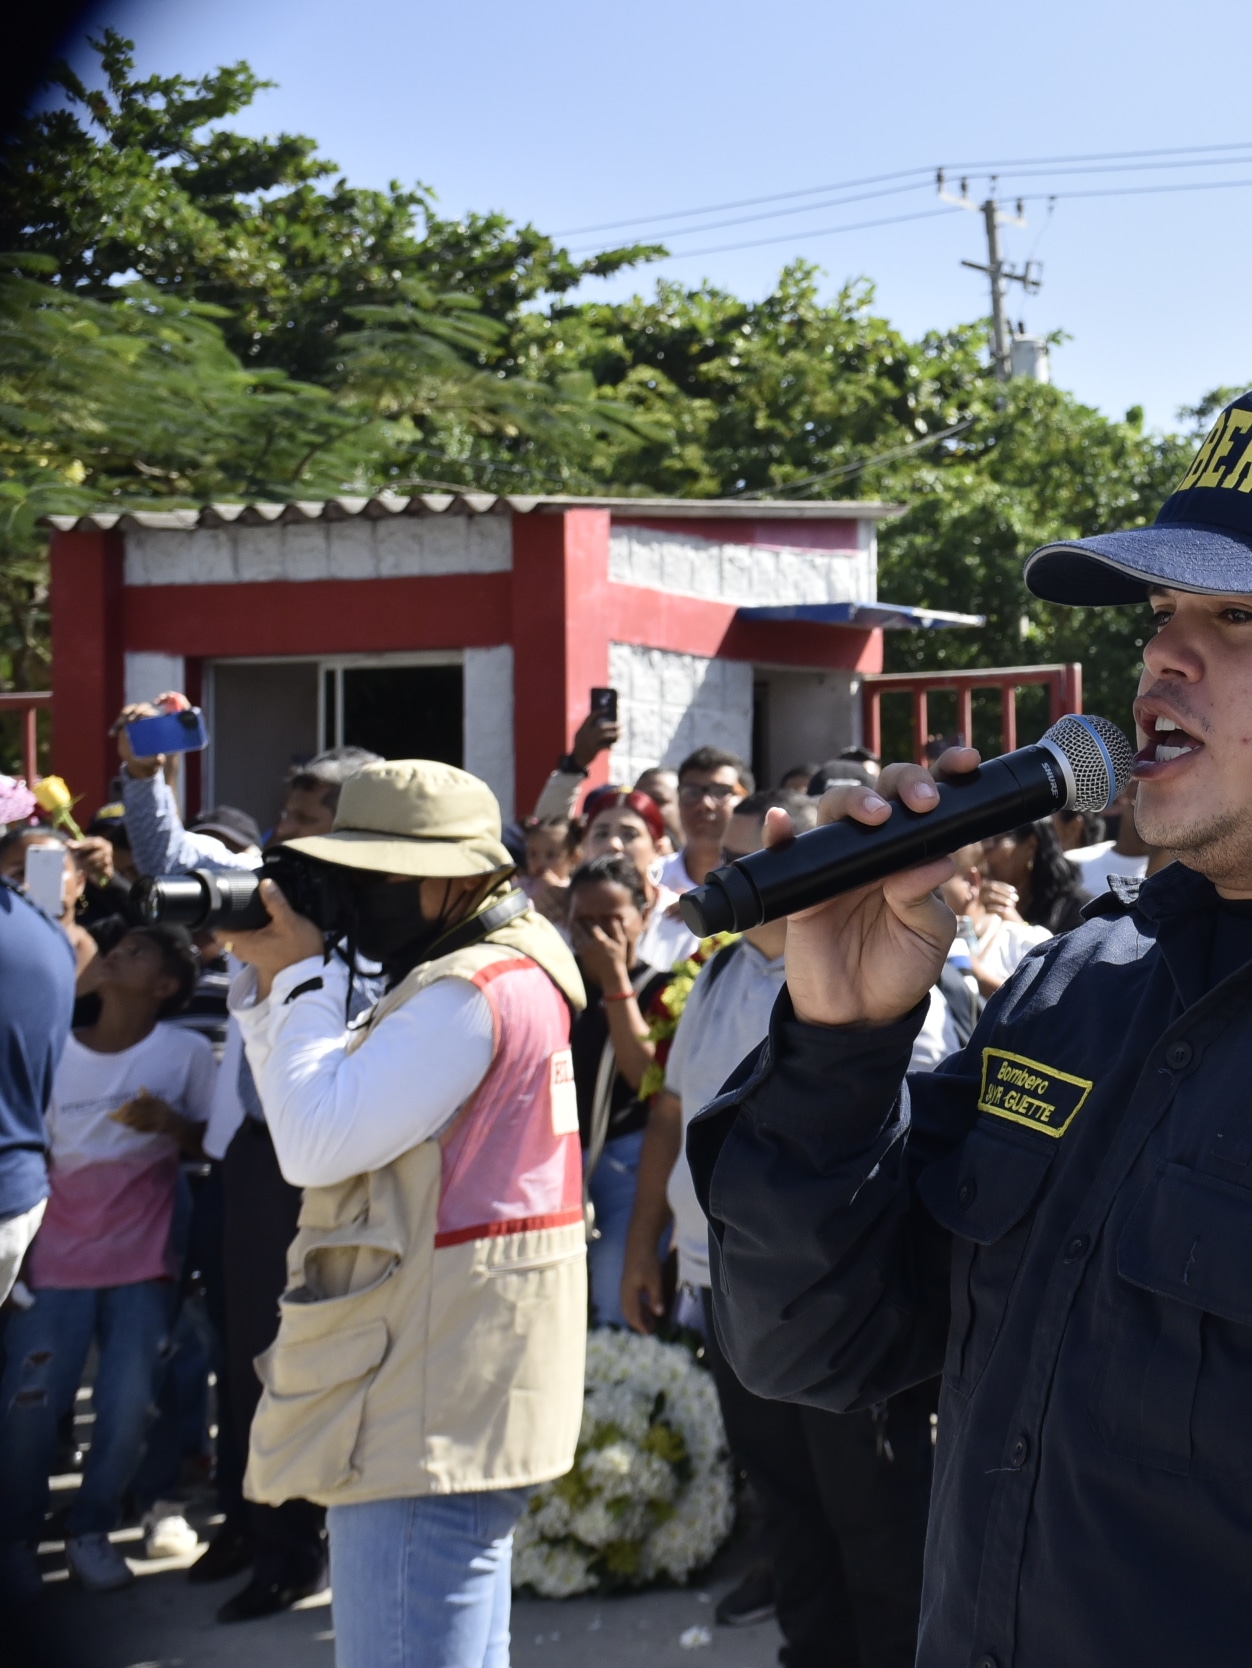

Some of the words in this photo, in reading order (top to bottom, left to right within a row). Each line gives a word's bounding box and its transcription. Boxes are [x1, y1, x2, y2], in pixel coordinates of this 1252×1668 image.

[1041, 762, 1058, 797] SHURE
[997, 1061, 1049, 1094] Bombero
[1004, 1091, 1056, 1121] GUETTE
